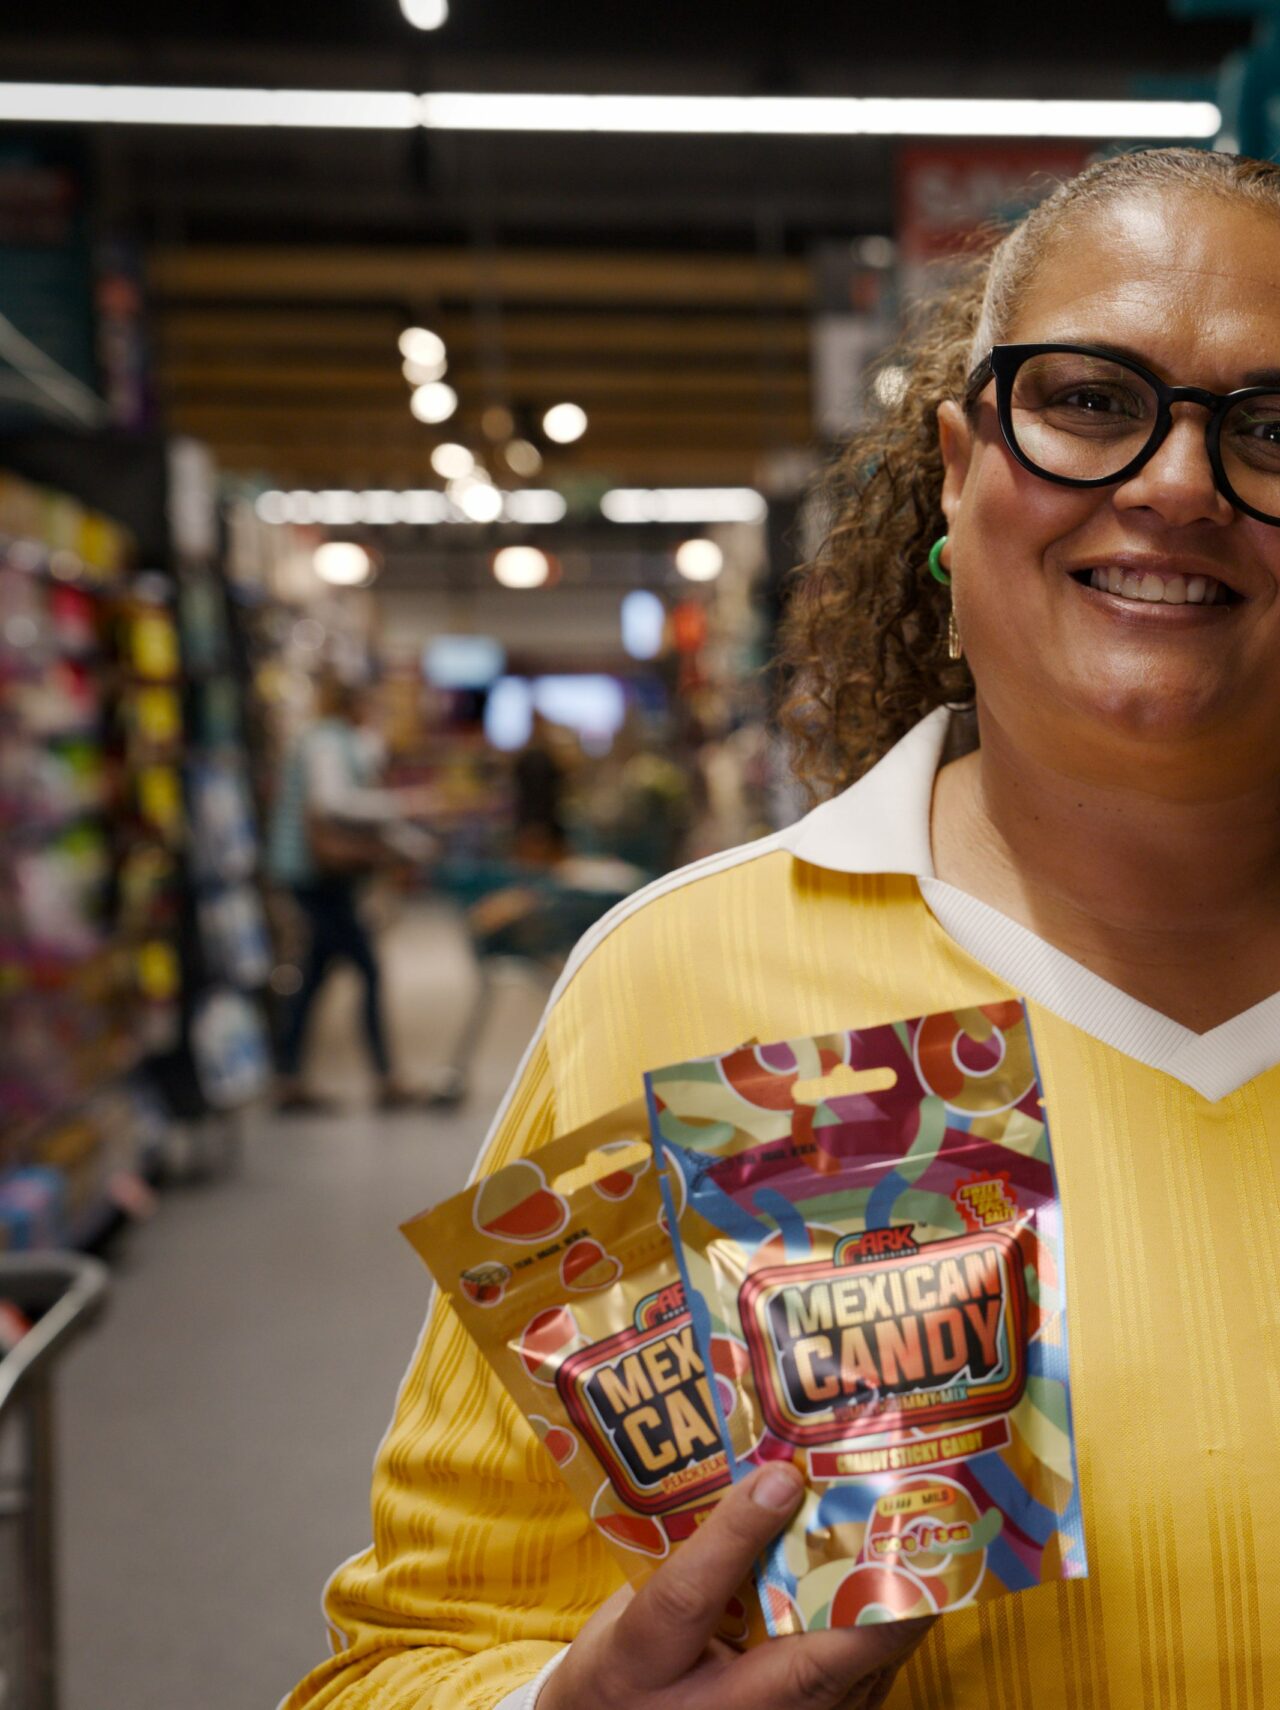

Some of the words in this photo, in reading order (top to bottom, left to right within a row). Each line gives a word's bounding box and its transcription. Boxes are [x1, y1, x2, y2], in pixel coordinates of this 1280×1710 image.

[861, 1225, 915, 1255] ARK
[784, 1248, 1000, 1338] MEXICAN
[793, 1300, 1000, 1401] CANDY
[889, 1441, 938, 1469] STICKY
[940, 1430, 983, 1459] CANDY
